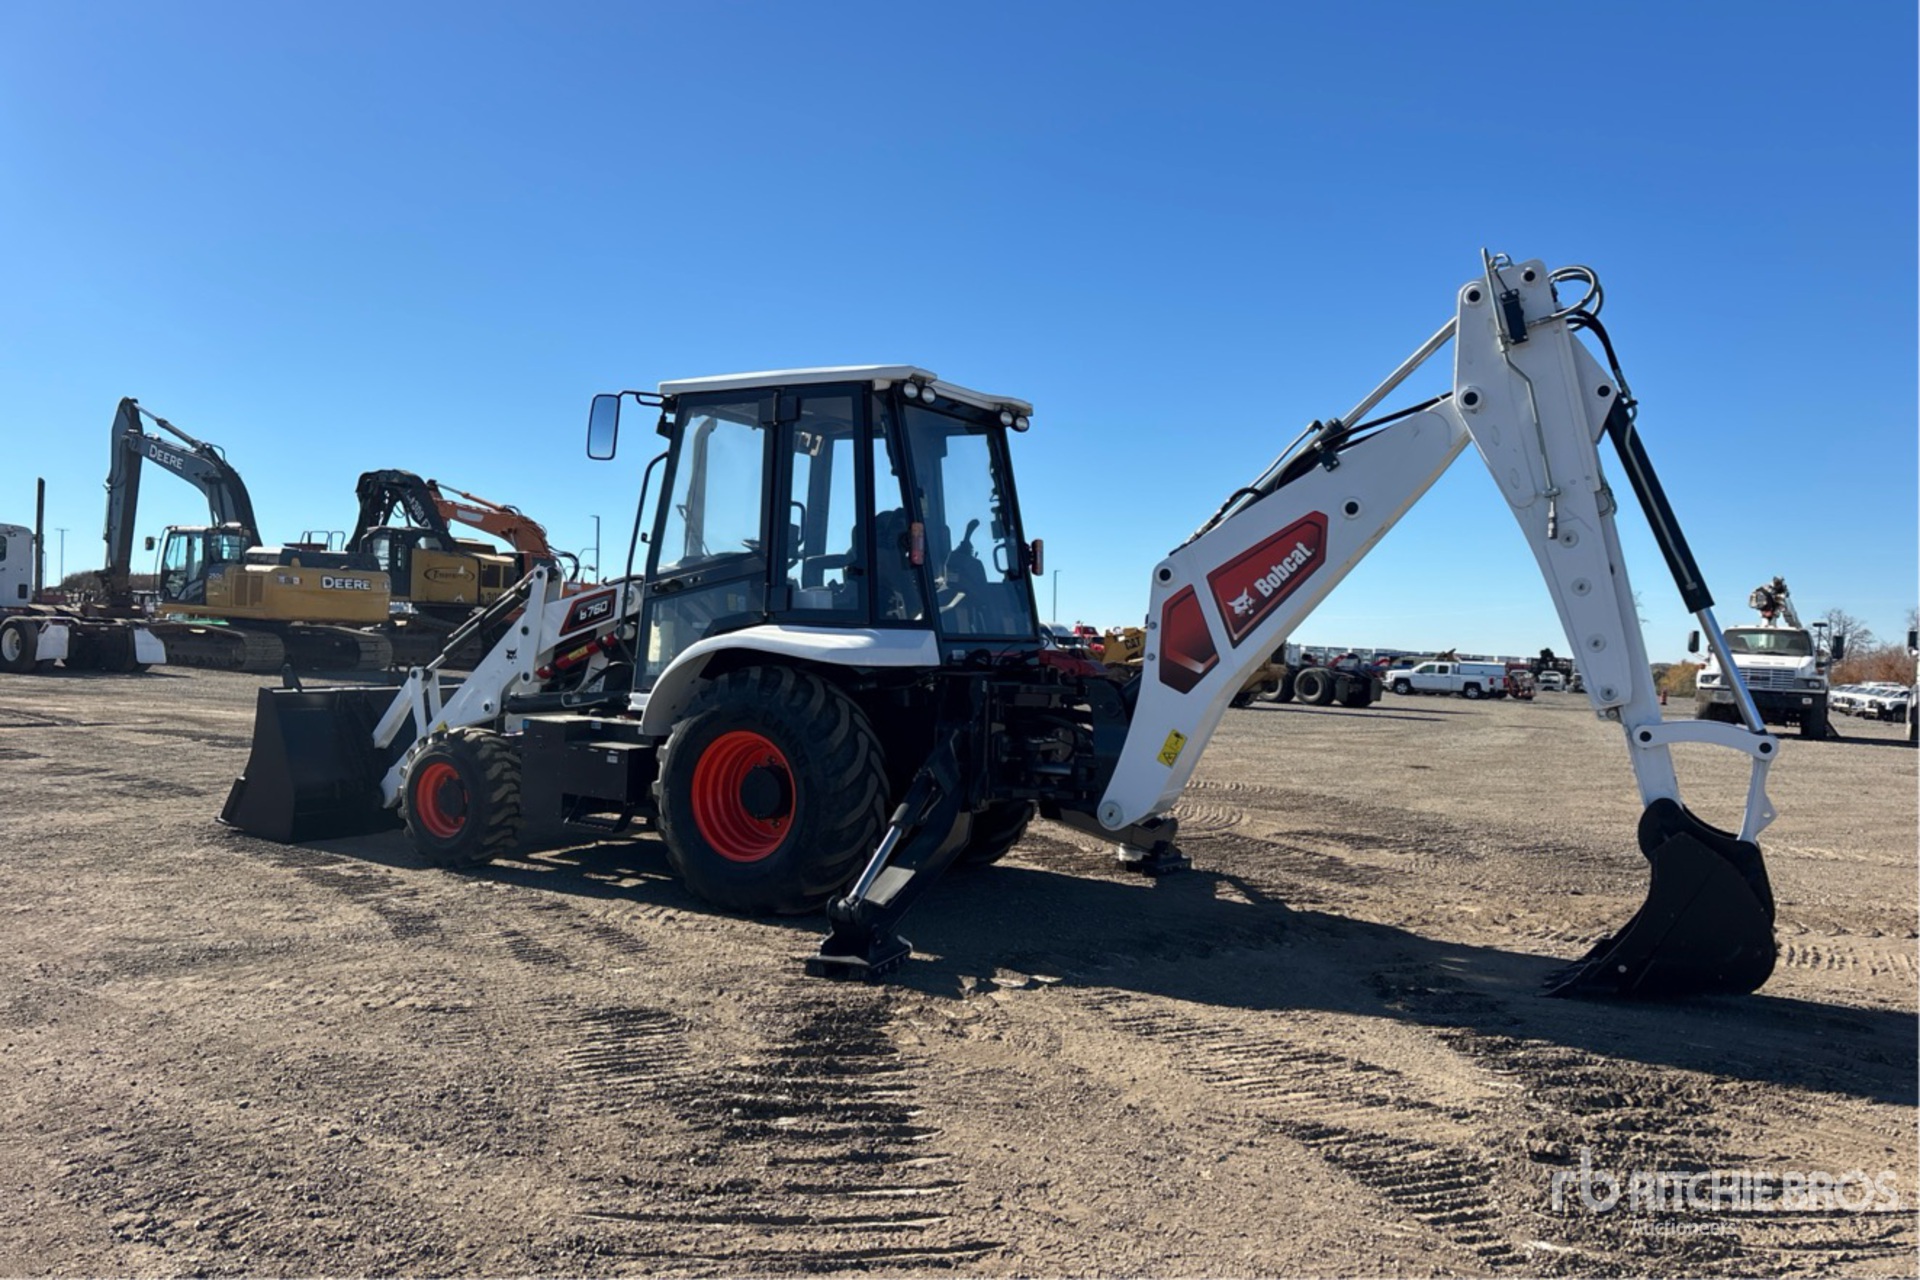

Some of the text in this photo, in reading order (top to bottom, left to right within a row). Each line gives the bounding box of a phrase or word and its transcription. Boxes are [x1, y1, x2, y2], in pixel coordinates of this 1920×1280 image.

[149, 444, 184, 470] DEERE
[1254, 542, 1312, 598] Bobcat
[322, 576, 371, 590] DEERE
[1125, 637, 1140, 650] CAT
